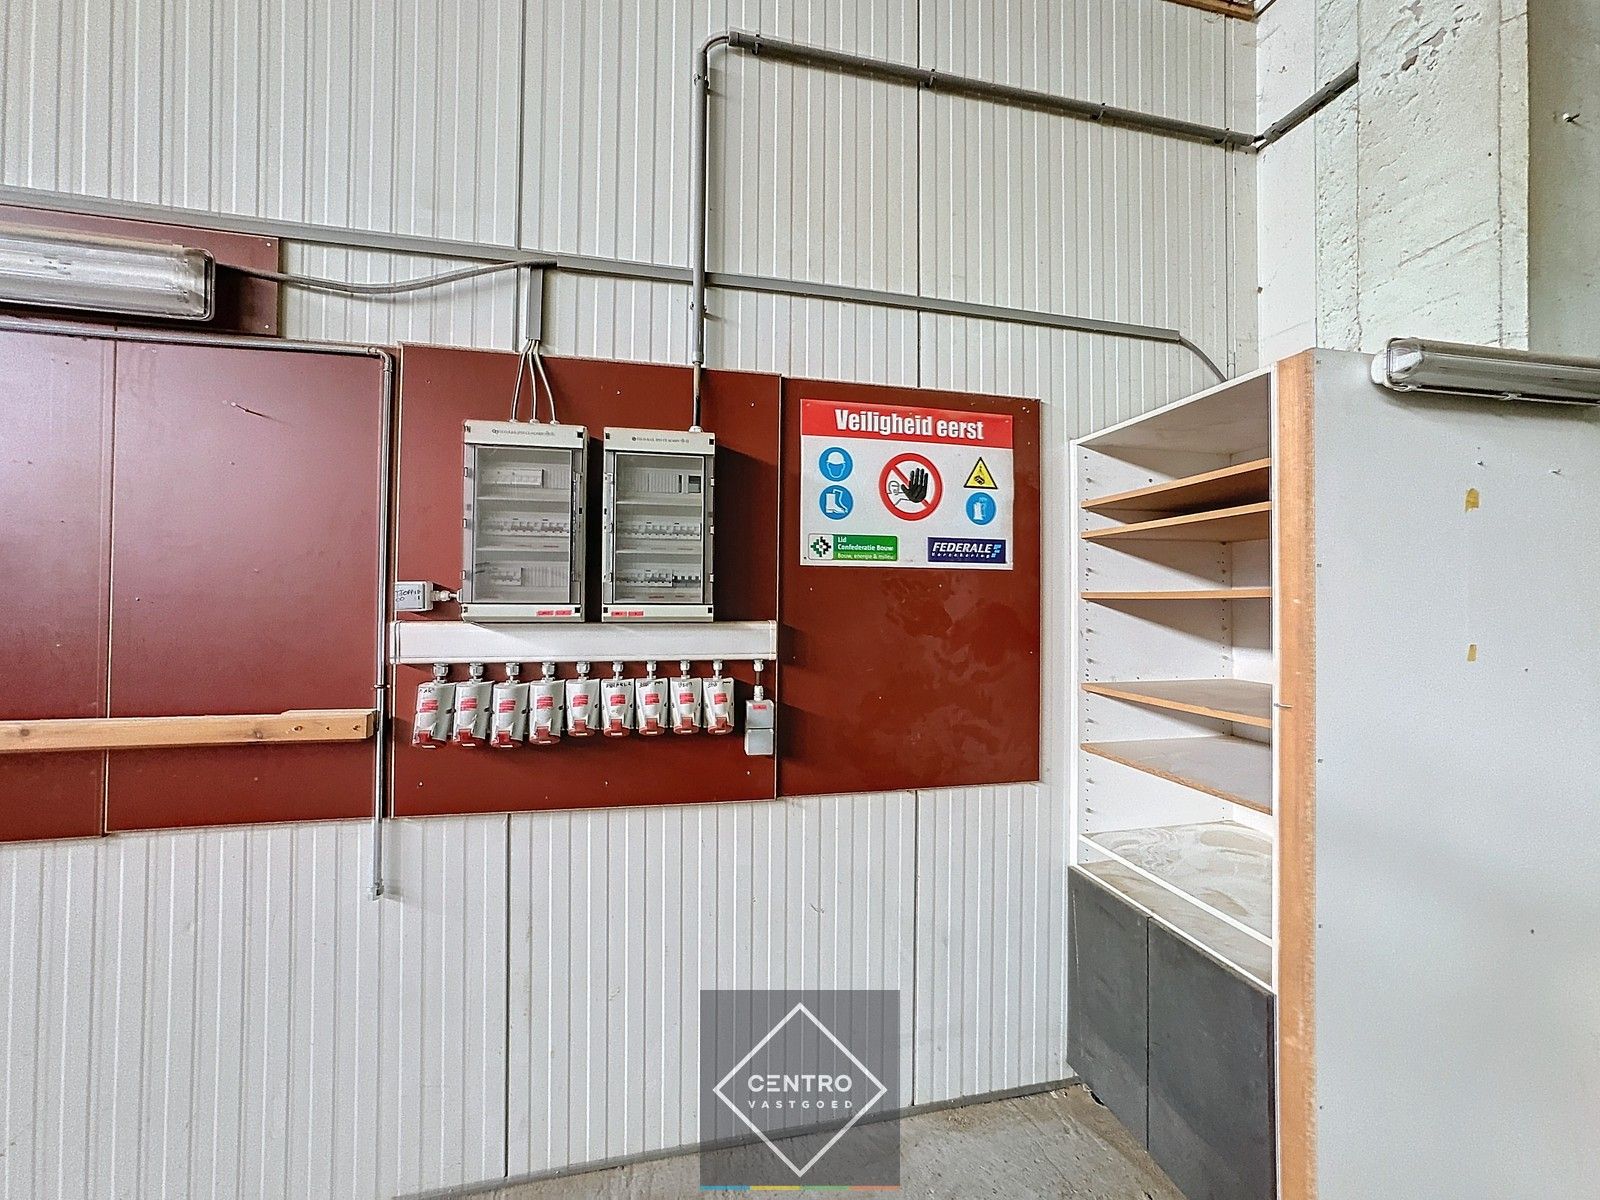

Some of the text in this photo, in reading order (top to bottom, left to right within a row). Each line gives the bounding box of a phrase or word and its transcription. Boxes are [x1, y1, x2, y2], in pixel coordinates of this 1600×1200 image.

[834, 408, 985, 440] Veiligheid eerst
[837, 543, 876, 551] Confederatie
[932, 542, 994, 553] FEDERALE
